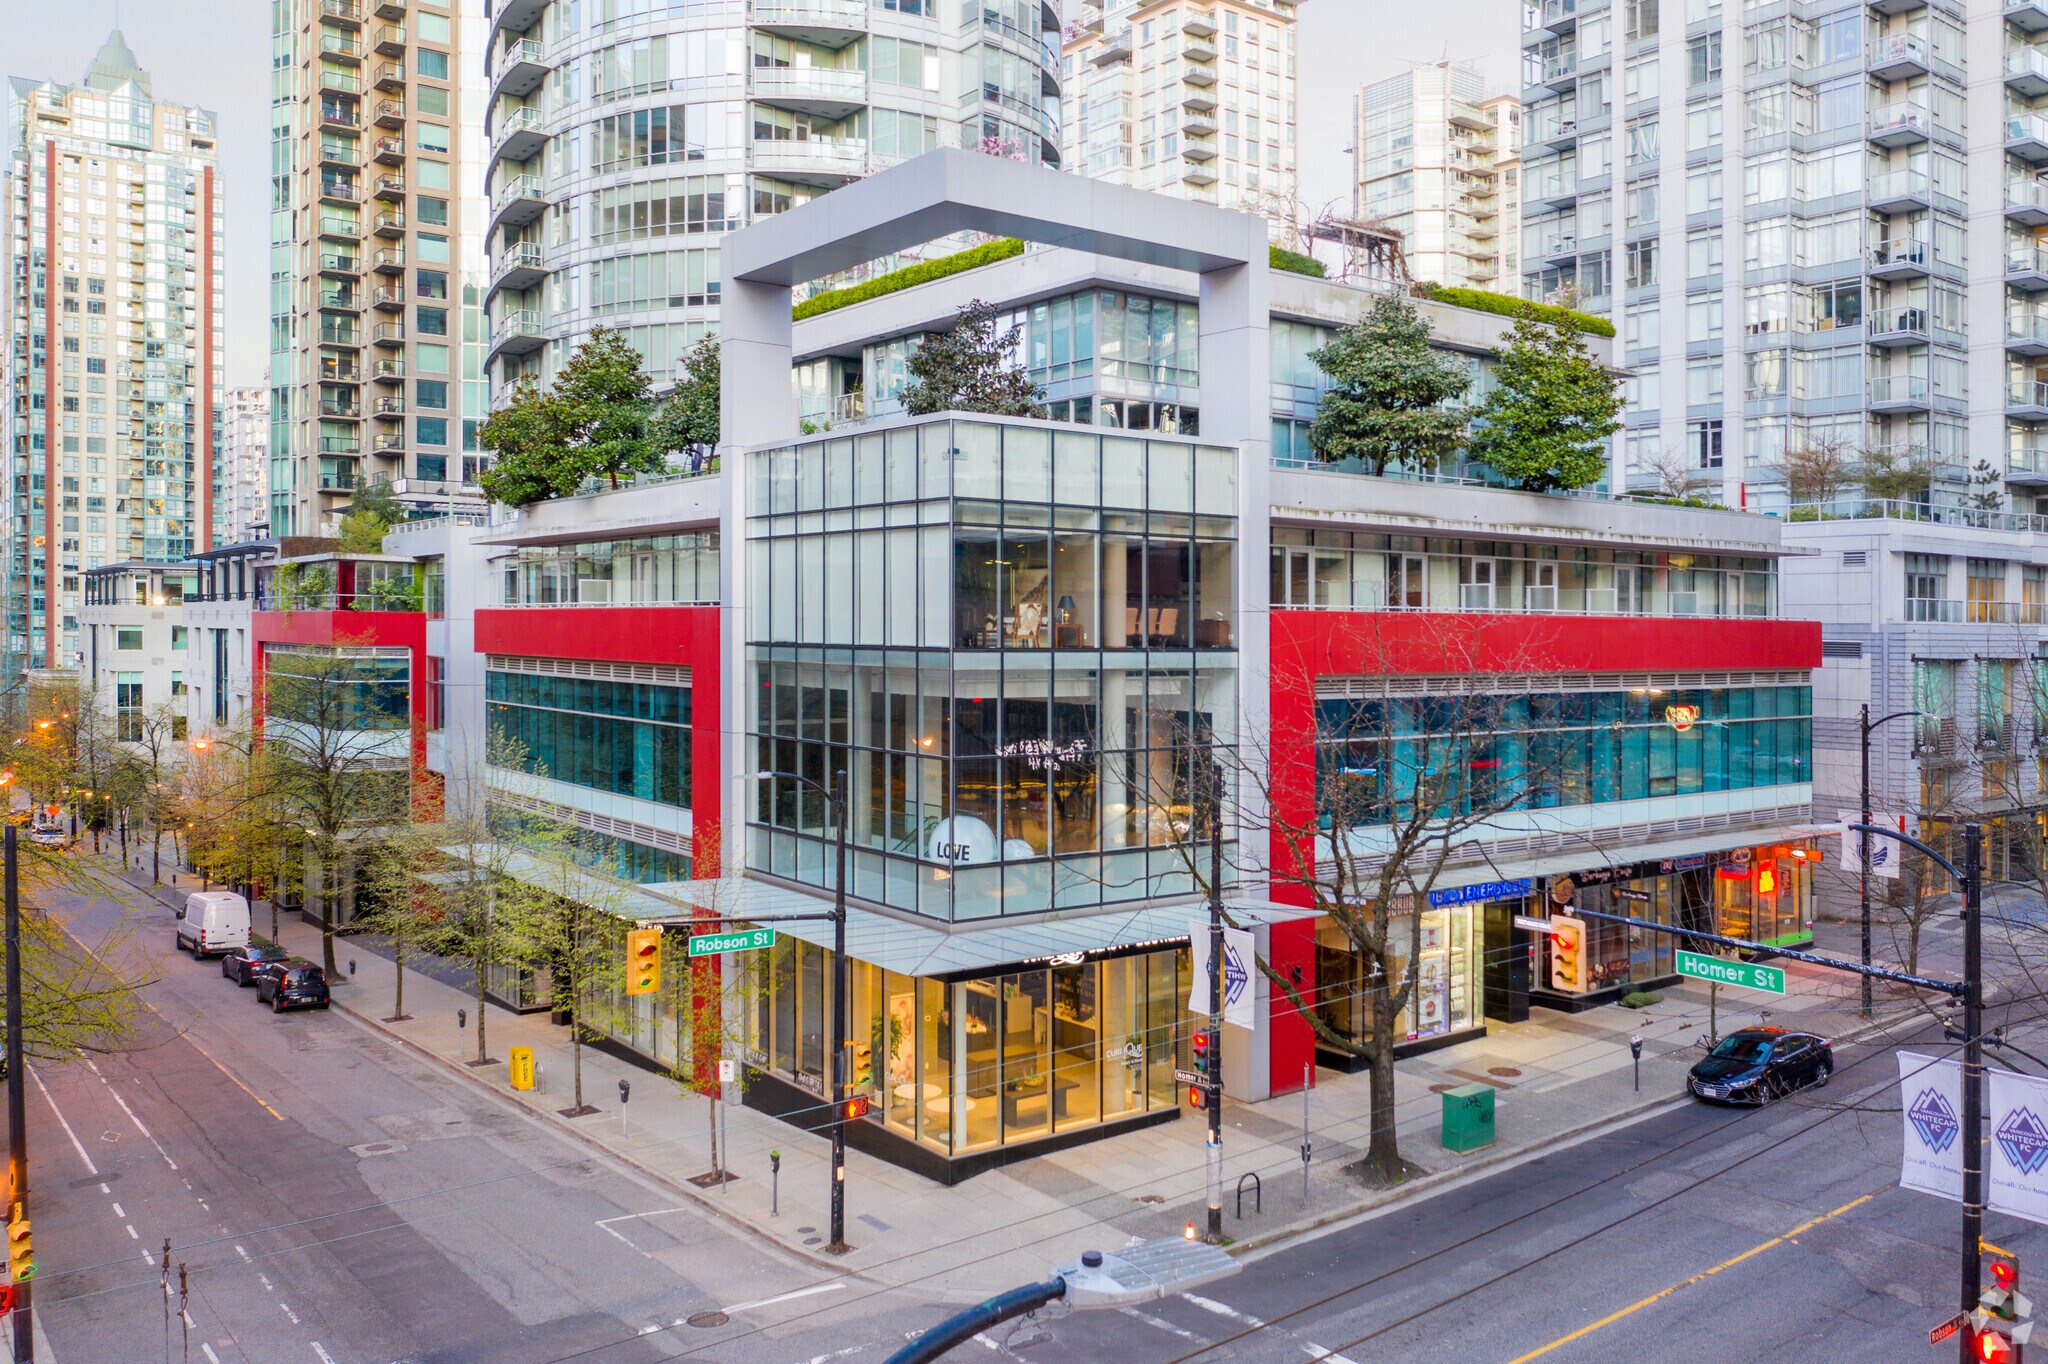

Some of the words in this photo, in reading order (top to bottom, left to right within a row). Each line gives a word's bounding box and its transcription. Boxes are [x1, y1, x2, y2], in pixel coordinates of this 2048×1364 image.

[937, 841, 970, 861] LOVE
[1466, 881, 1507, 900] ENERGY
[695, 936, 748, 953] Robson
[753, 932, 768, 946] St
[1684, 956, 1745, 982] Homer
[1754, 969, 1776, 988] St
[1106, 1043, 1143, 1058] CURLIQUE
[1177, 1071, 1197, 1082] Homer
[1909, 1111, 1958, 1130] WHITECAPS
[1920, 1108, 1952, 1120] VANCOUVER
[2009, 1128, 2043, 1139] VANCOUVER
[2019, 1144, 2031, 1153] FC
[1931, 1324, 1952, 1343] Robson
